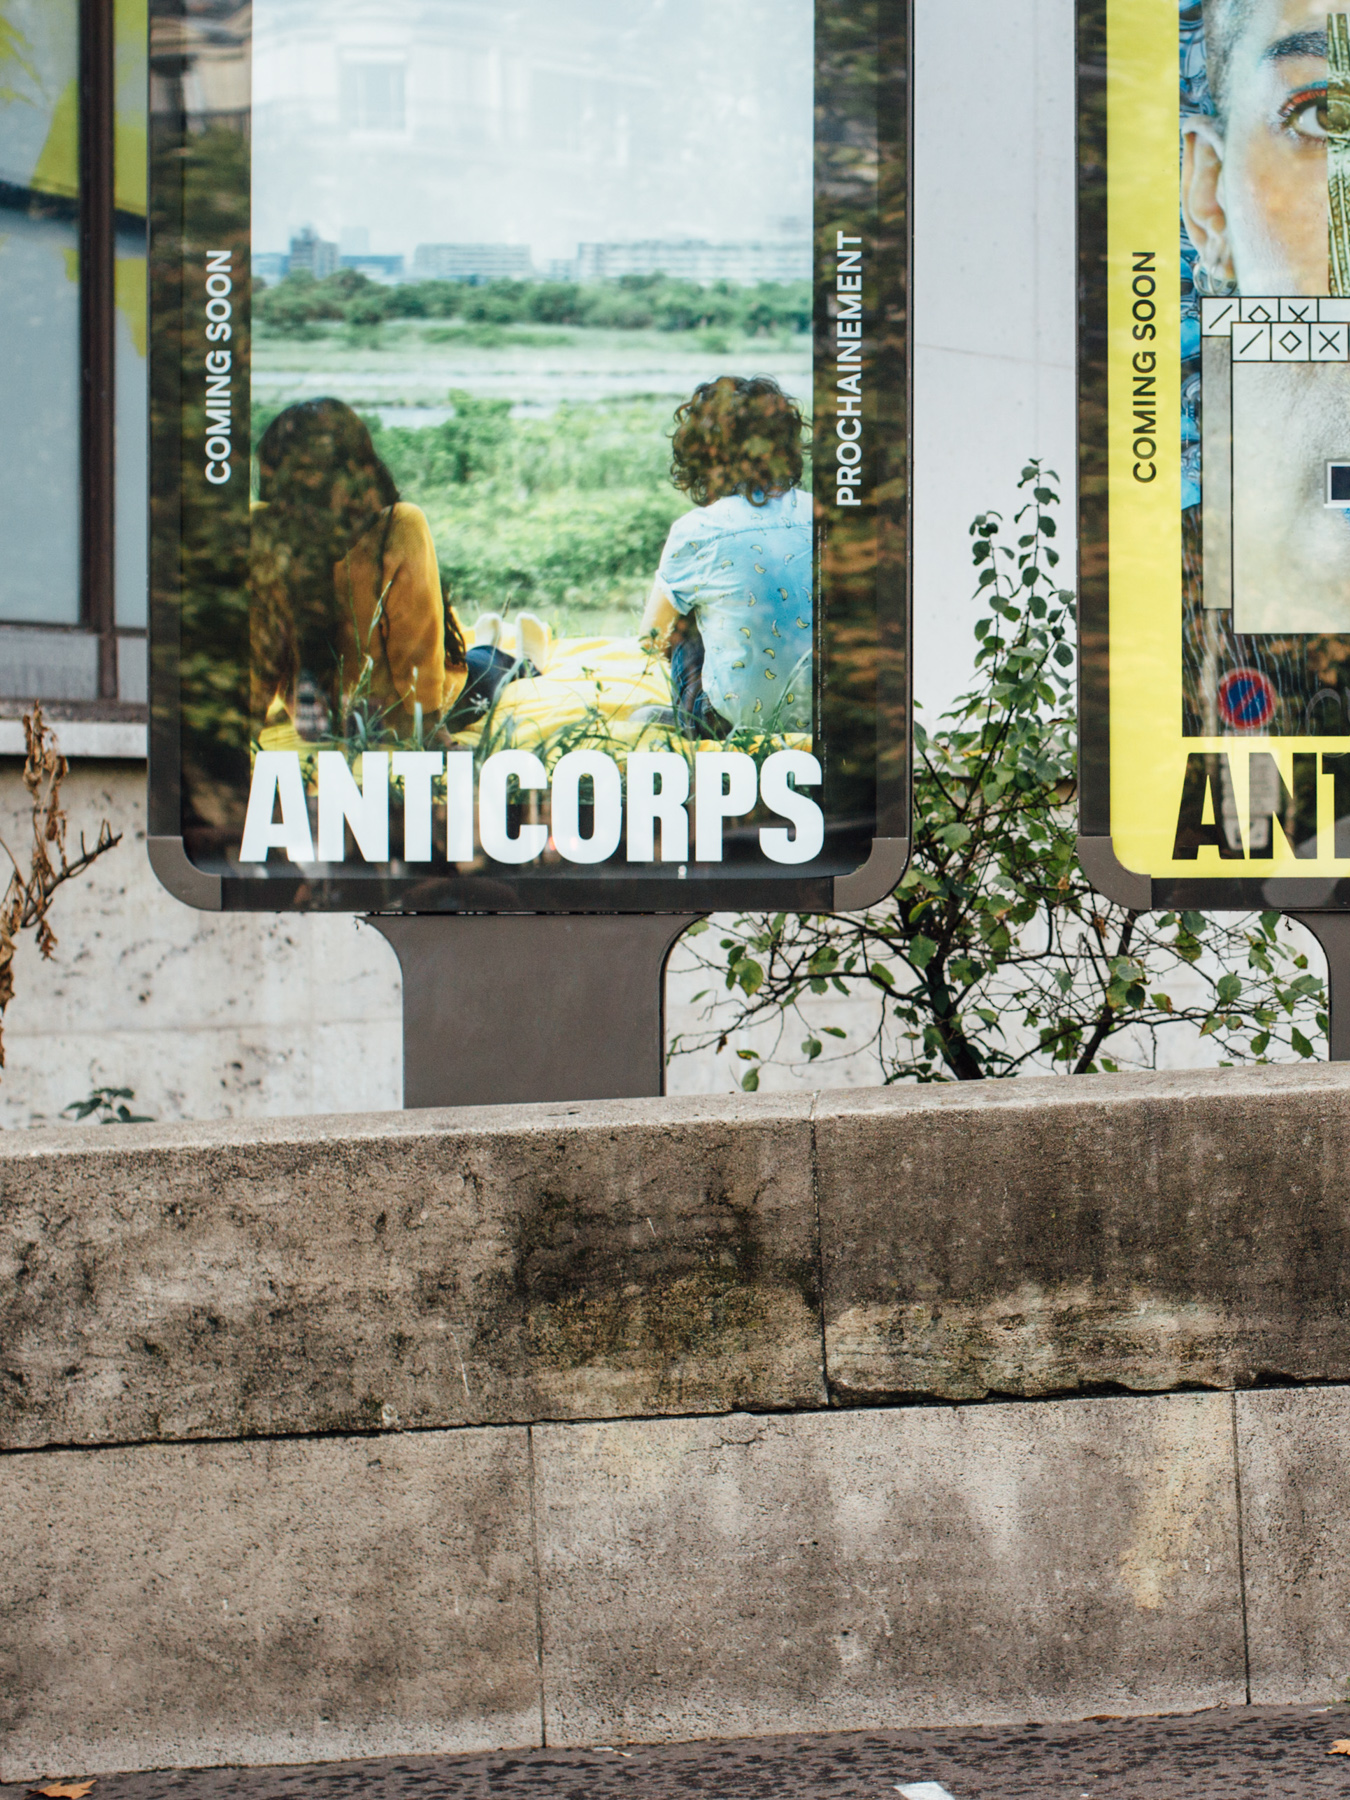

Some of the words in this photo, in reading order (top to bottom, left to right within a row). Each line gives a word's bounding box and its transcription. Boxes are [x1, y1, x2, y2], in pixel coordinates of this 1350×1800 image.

[205, 250, 232, 342] SOON
[1132, 252, 1156, 341] SOON
[205, 350, 232, 485] COMING
[836, 230, 863, 507] PROCHAINEMENT
[1132, 351, 1157, 483] COMING
[238, 749, 825, 864] ANTICORPS
